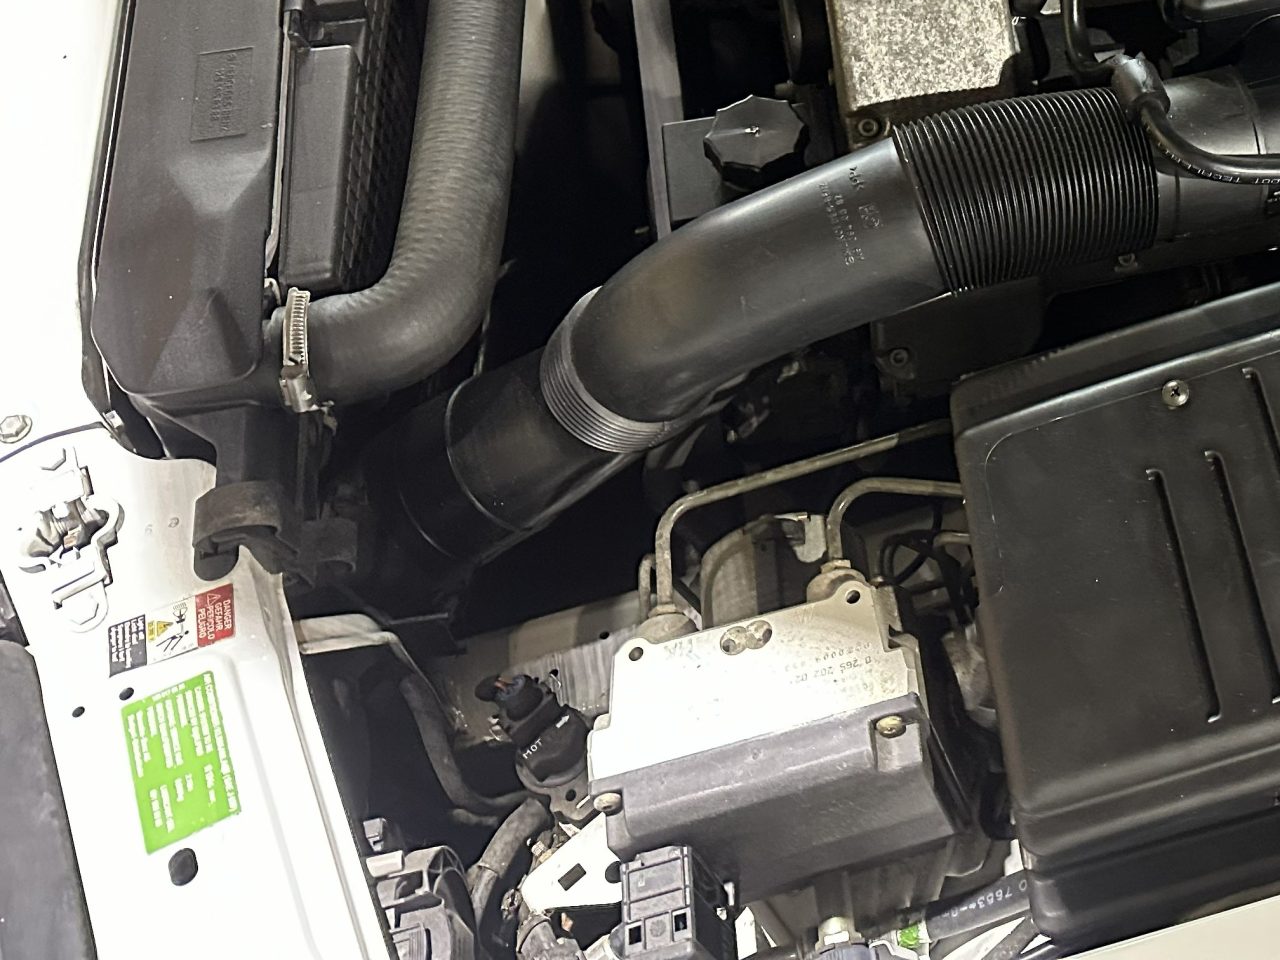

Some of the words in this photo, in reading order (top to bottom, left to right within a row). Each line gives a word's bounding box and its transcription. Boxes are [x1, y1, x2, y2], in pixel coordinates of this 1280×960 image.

[214, 602, 223, 631] GEFAHR
[222, 599, 232, 630] DANGER
[522, 738, 543, 760] MOT
